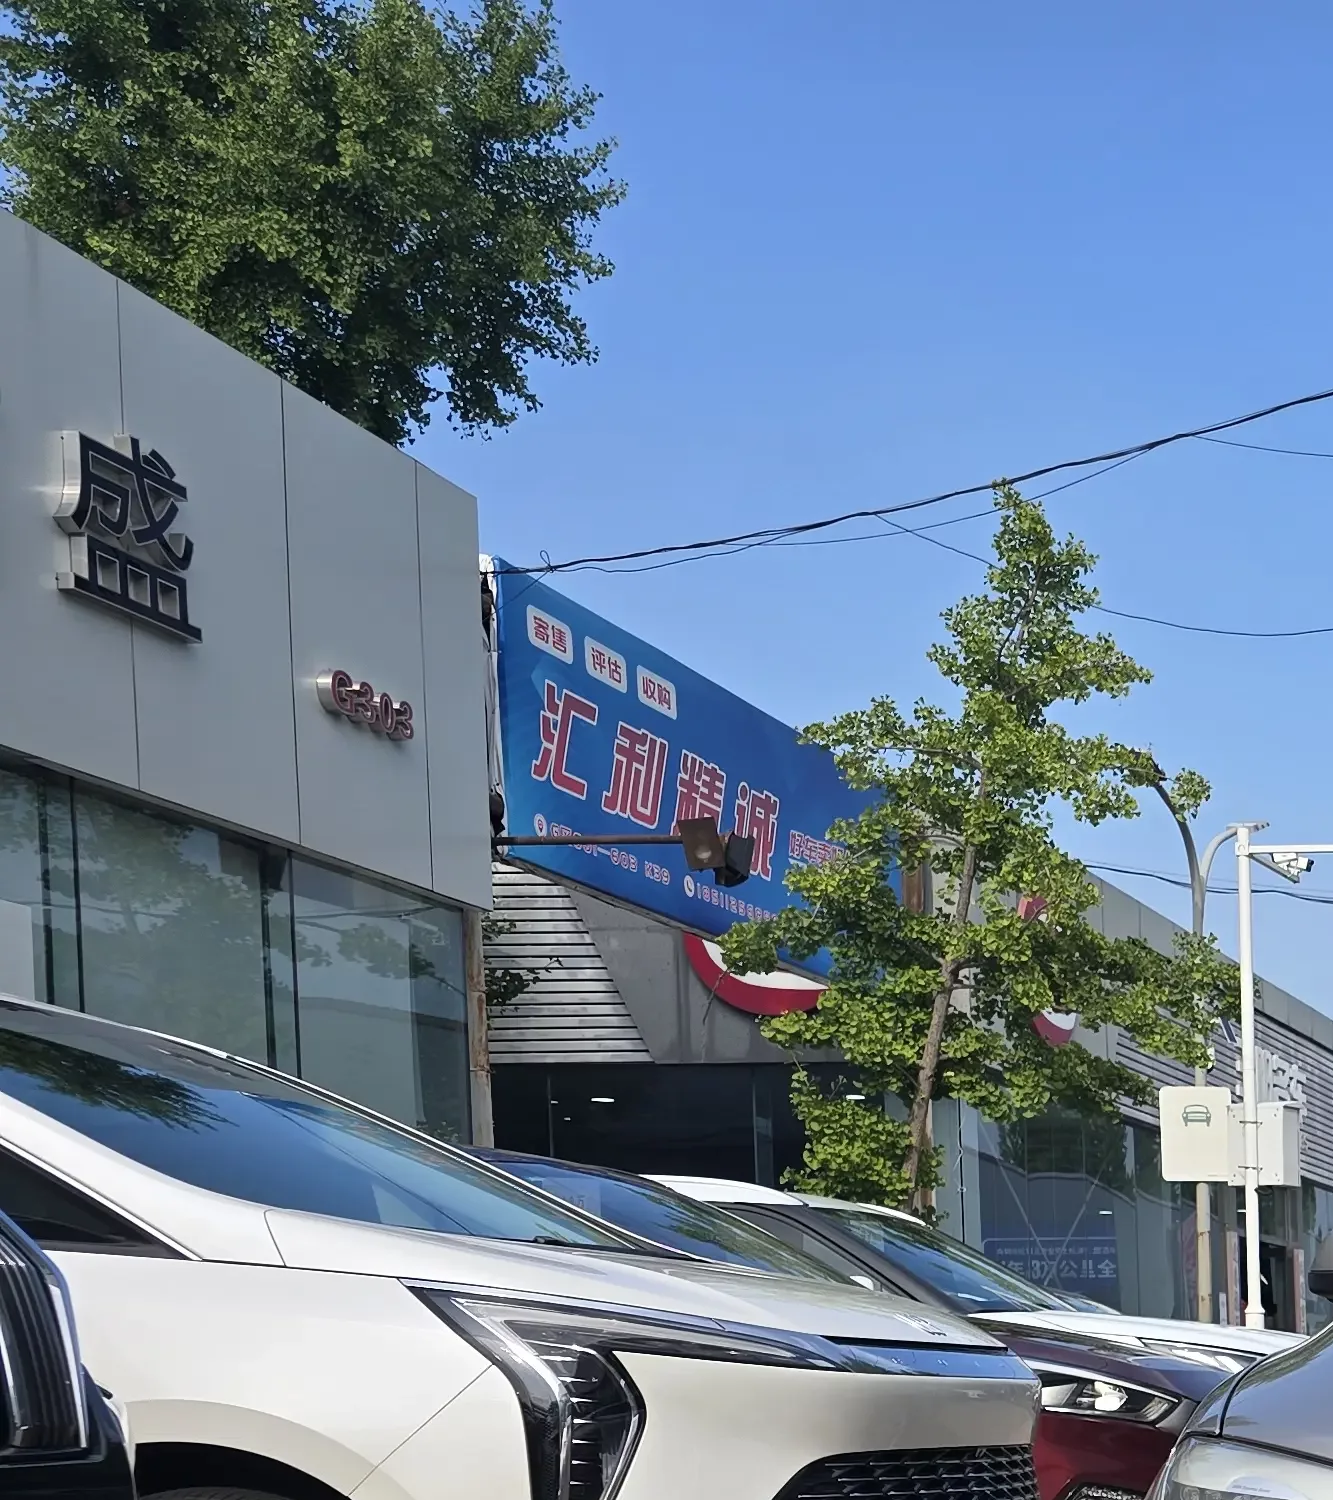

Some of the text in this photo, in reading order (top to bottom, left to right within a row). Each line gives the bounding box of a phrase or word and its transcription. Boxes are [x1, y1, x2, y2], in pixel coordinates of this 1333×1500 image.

[53, 430, 203, 643] 盛
[316, 668, 414, 741] G303
[533, 615, 673, 712] 寄售 评估 收购
[530, 679, 780, 881] 汇利精诚
